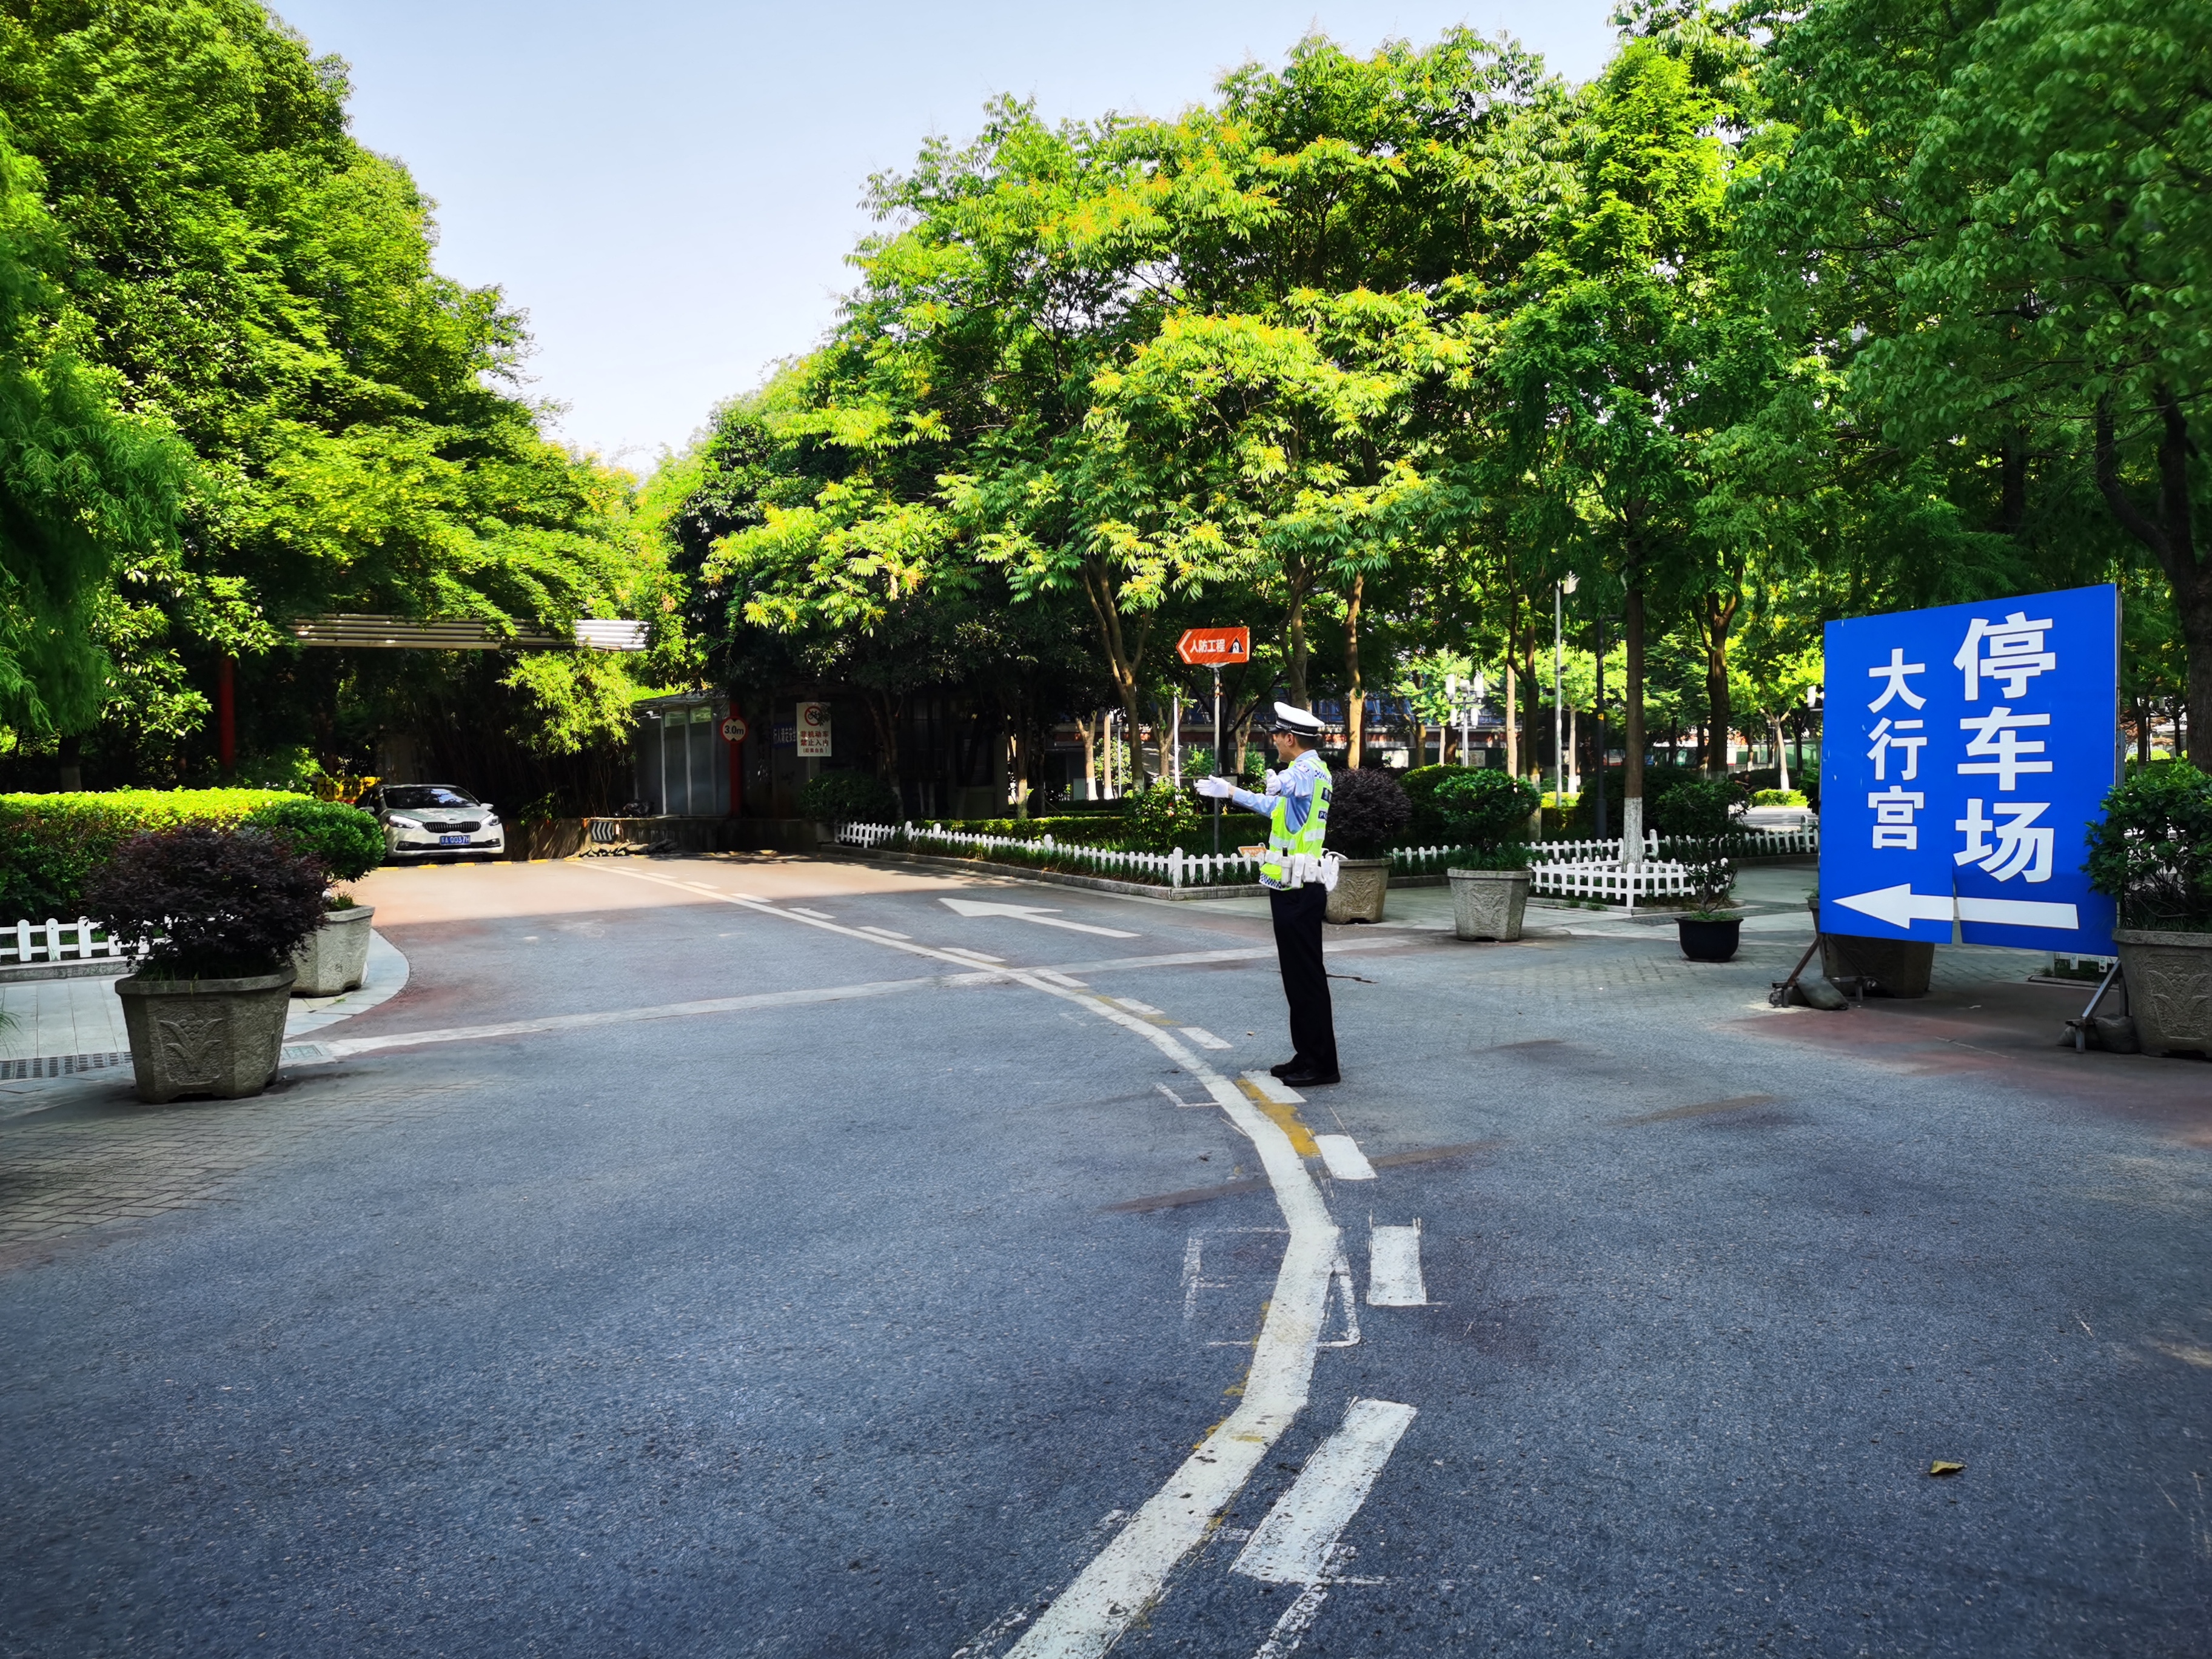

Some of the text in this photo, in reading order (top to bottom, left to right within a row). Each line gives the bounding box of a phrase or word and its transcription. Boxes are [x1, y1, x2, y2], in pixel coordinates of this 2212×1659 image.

[1190, 638, 1225, 653] 人防工程
[725, 725, 744, 734] 3.0m
[1868, 648, 1928, 850] 大行宫
[1952, 611, 2056, 883] 停车场
